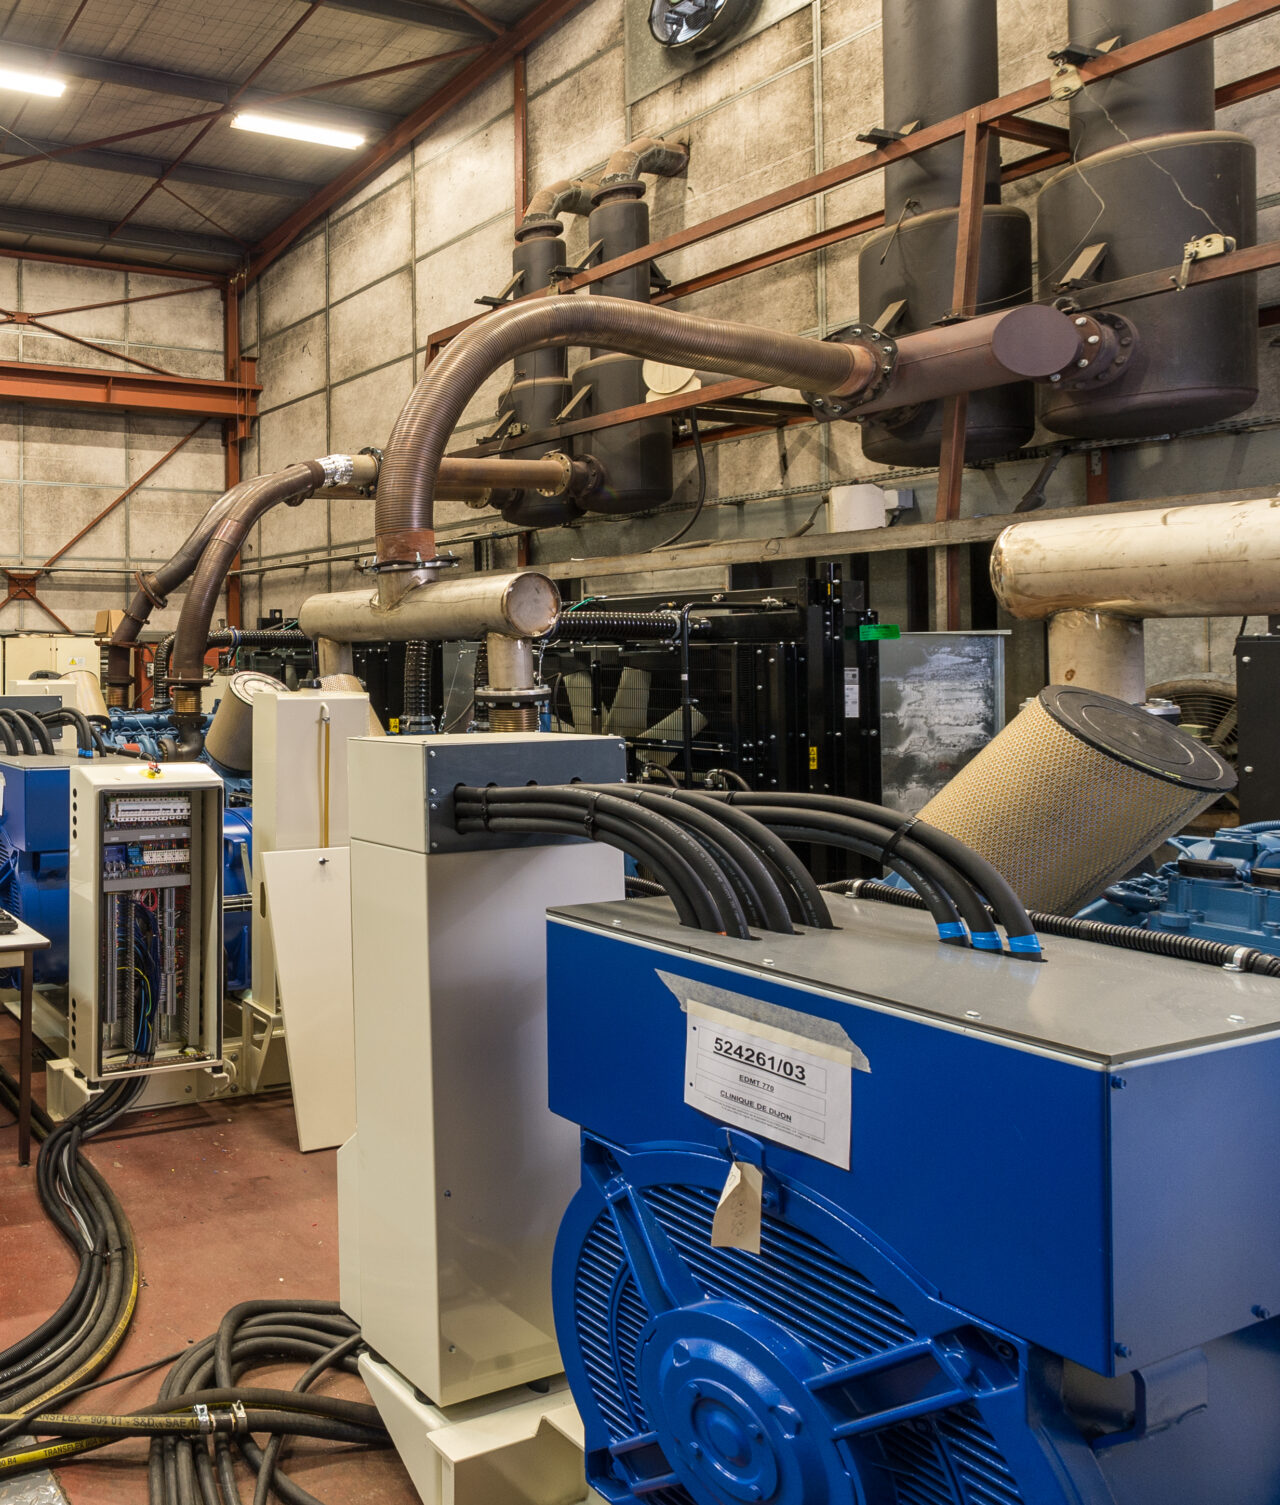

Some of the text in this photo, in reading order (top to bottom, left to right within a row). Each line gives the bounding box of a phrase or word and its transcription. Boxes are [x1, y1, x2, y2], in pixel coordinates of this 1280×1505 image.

[713, 1036, 806, 1083] 524261/03
[739, 1074, 760, 1087] EDMT
[720, 1090, 792, 1122] CLINIQUE DE DIJON
[91, 1416, 108, 1425] 904
[133, 1416, 155, 1428] S&D
[165, 1417, 186, 1429] SAE
[43, 1441, 84, 1457] TRANSFLEX
